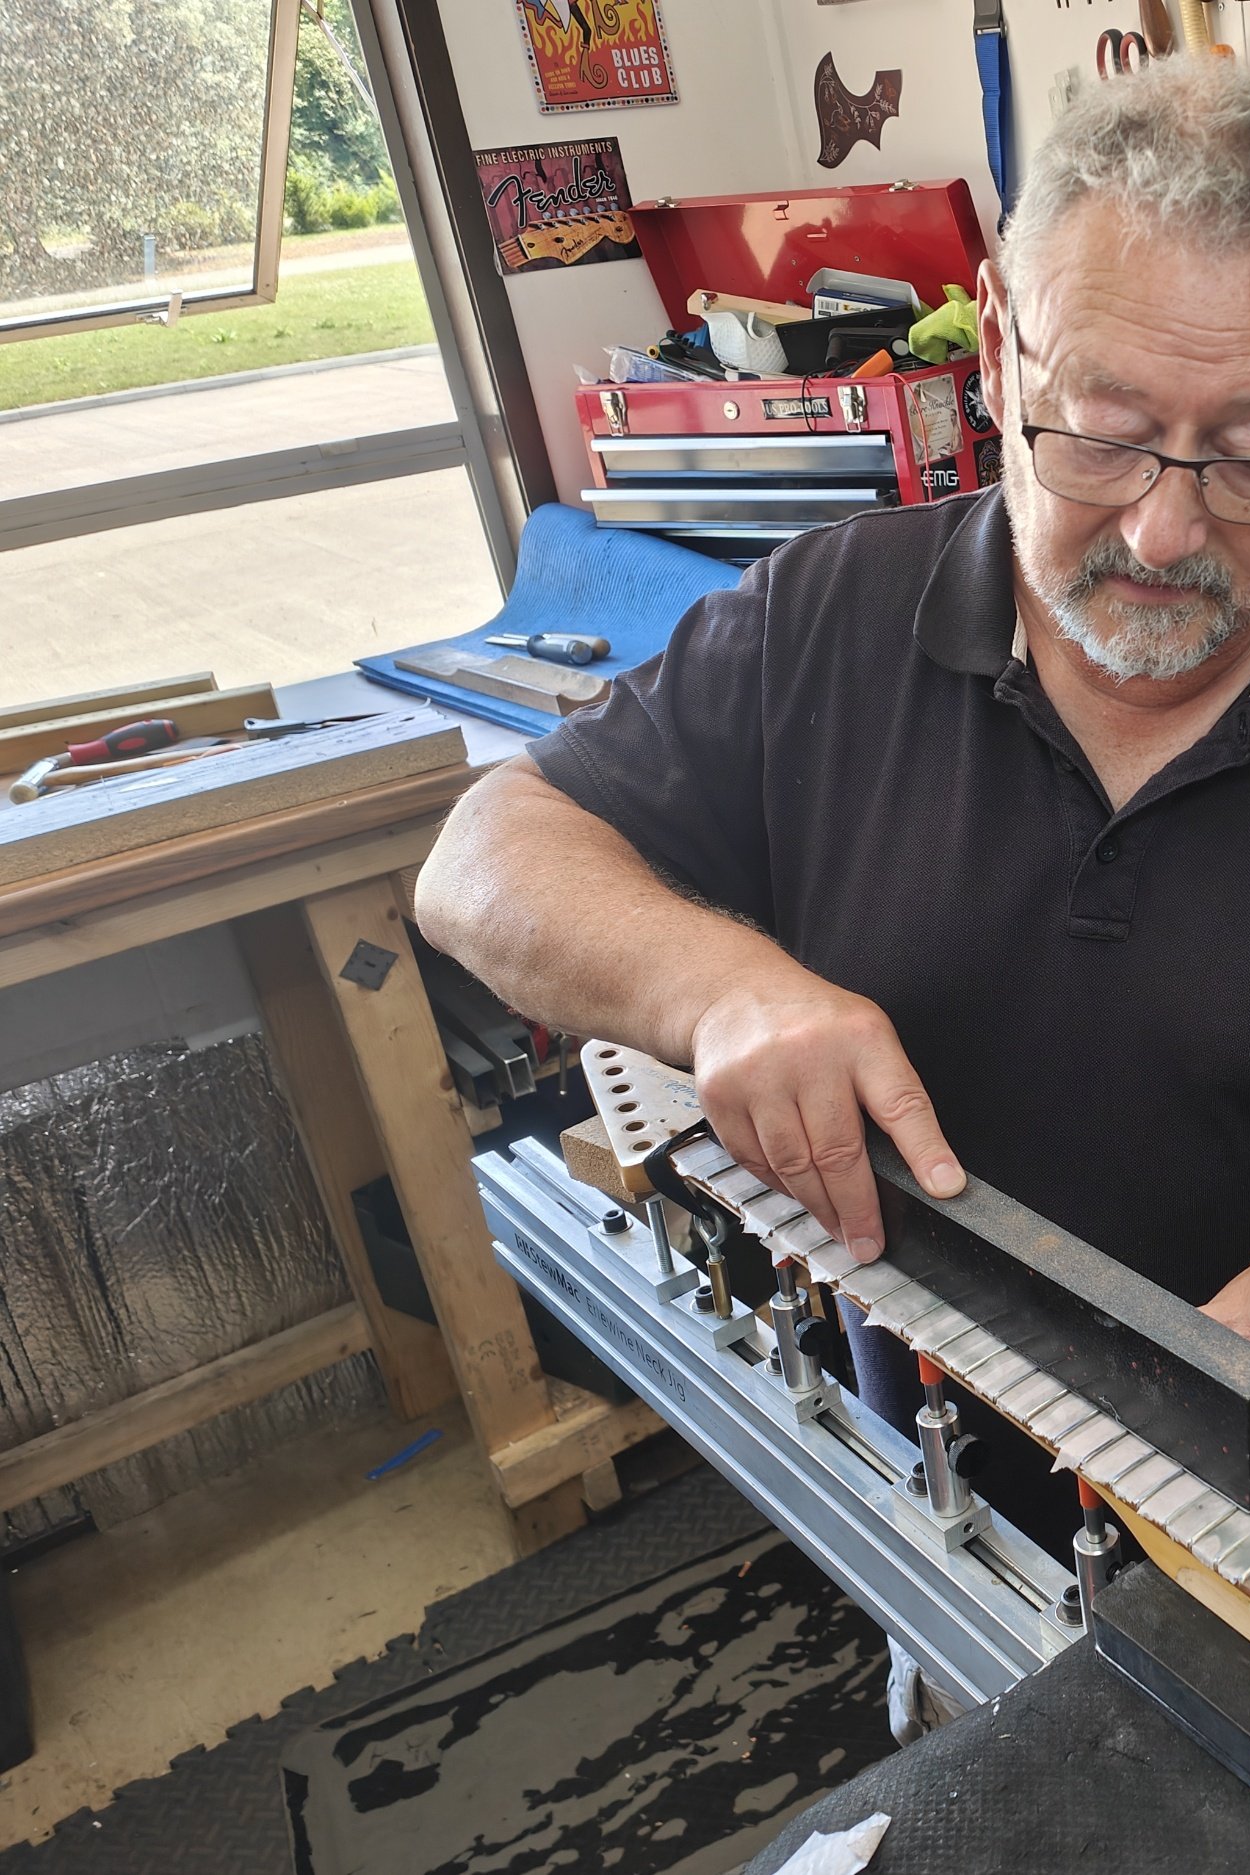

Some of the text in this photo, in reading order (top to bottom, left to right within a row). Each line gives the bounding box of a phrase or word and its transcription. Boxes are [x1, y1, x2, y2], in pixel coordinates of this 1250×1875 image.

[611, 46, 659, 68] BLUES
[617, 67, 663, 89] CLUB
[475, 141, 613, 167] FINE ELECTRIC INSTRUMENTS
[487, 156, 616, 229] Fender
[765, 402, 778, 415] US
[780, 401, 797, 414] PRO
[921, 470, 960, 487] EMG
[529, 1246, 686, 1402] StewMac Erlewine Neck Jig
